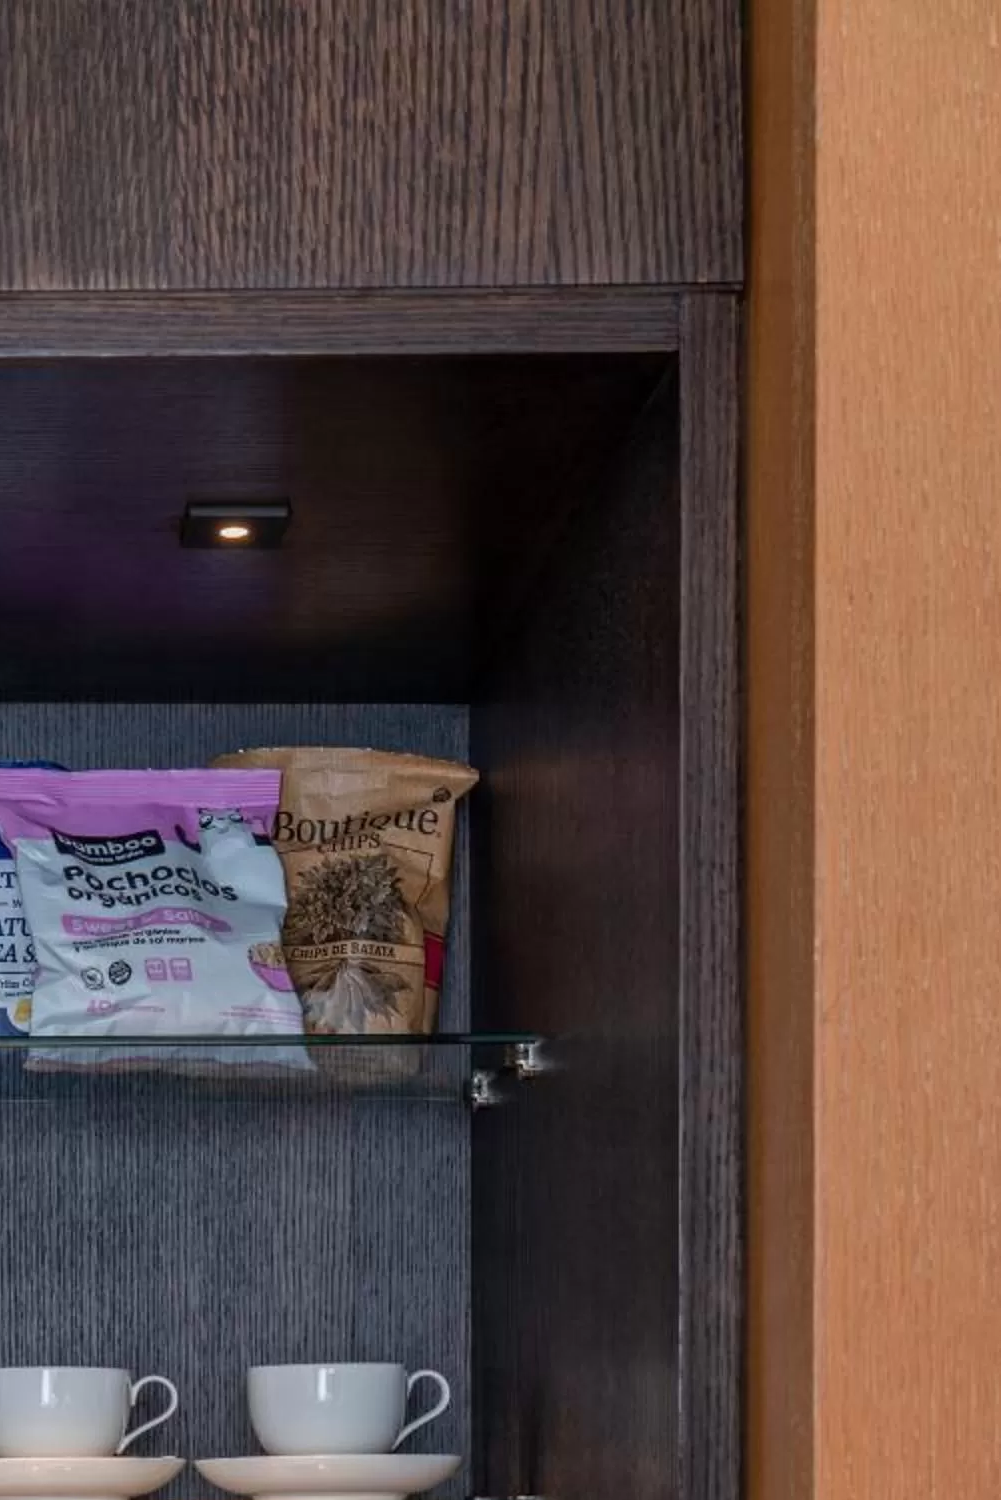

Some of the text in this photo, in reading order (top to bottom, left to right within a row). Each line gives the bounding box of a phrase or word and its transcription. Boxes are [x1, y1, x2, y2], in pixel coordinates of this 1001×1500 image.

[273, 806, 439, 844] Boutique
[316, 833, 381, 853] CHIPS
[62, 864, 239, 901] Pochoclos
[22, 942, 38, 963] S
[289, 946, 328, 960] CHIPS
[331, 943, 348, 955] DE
